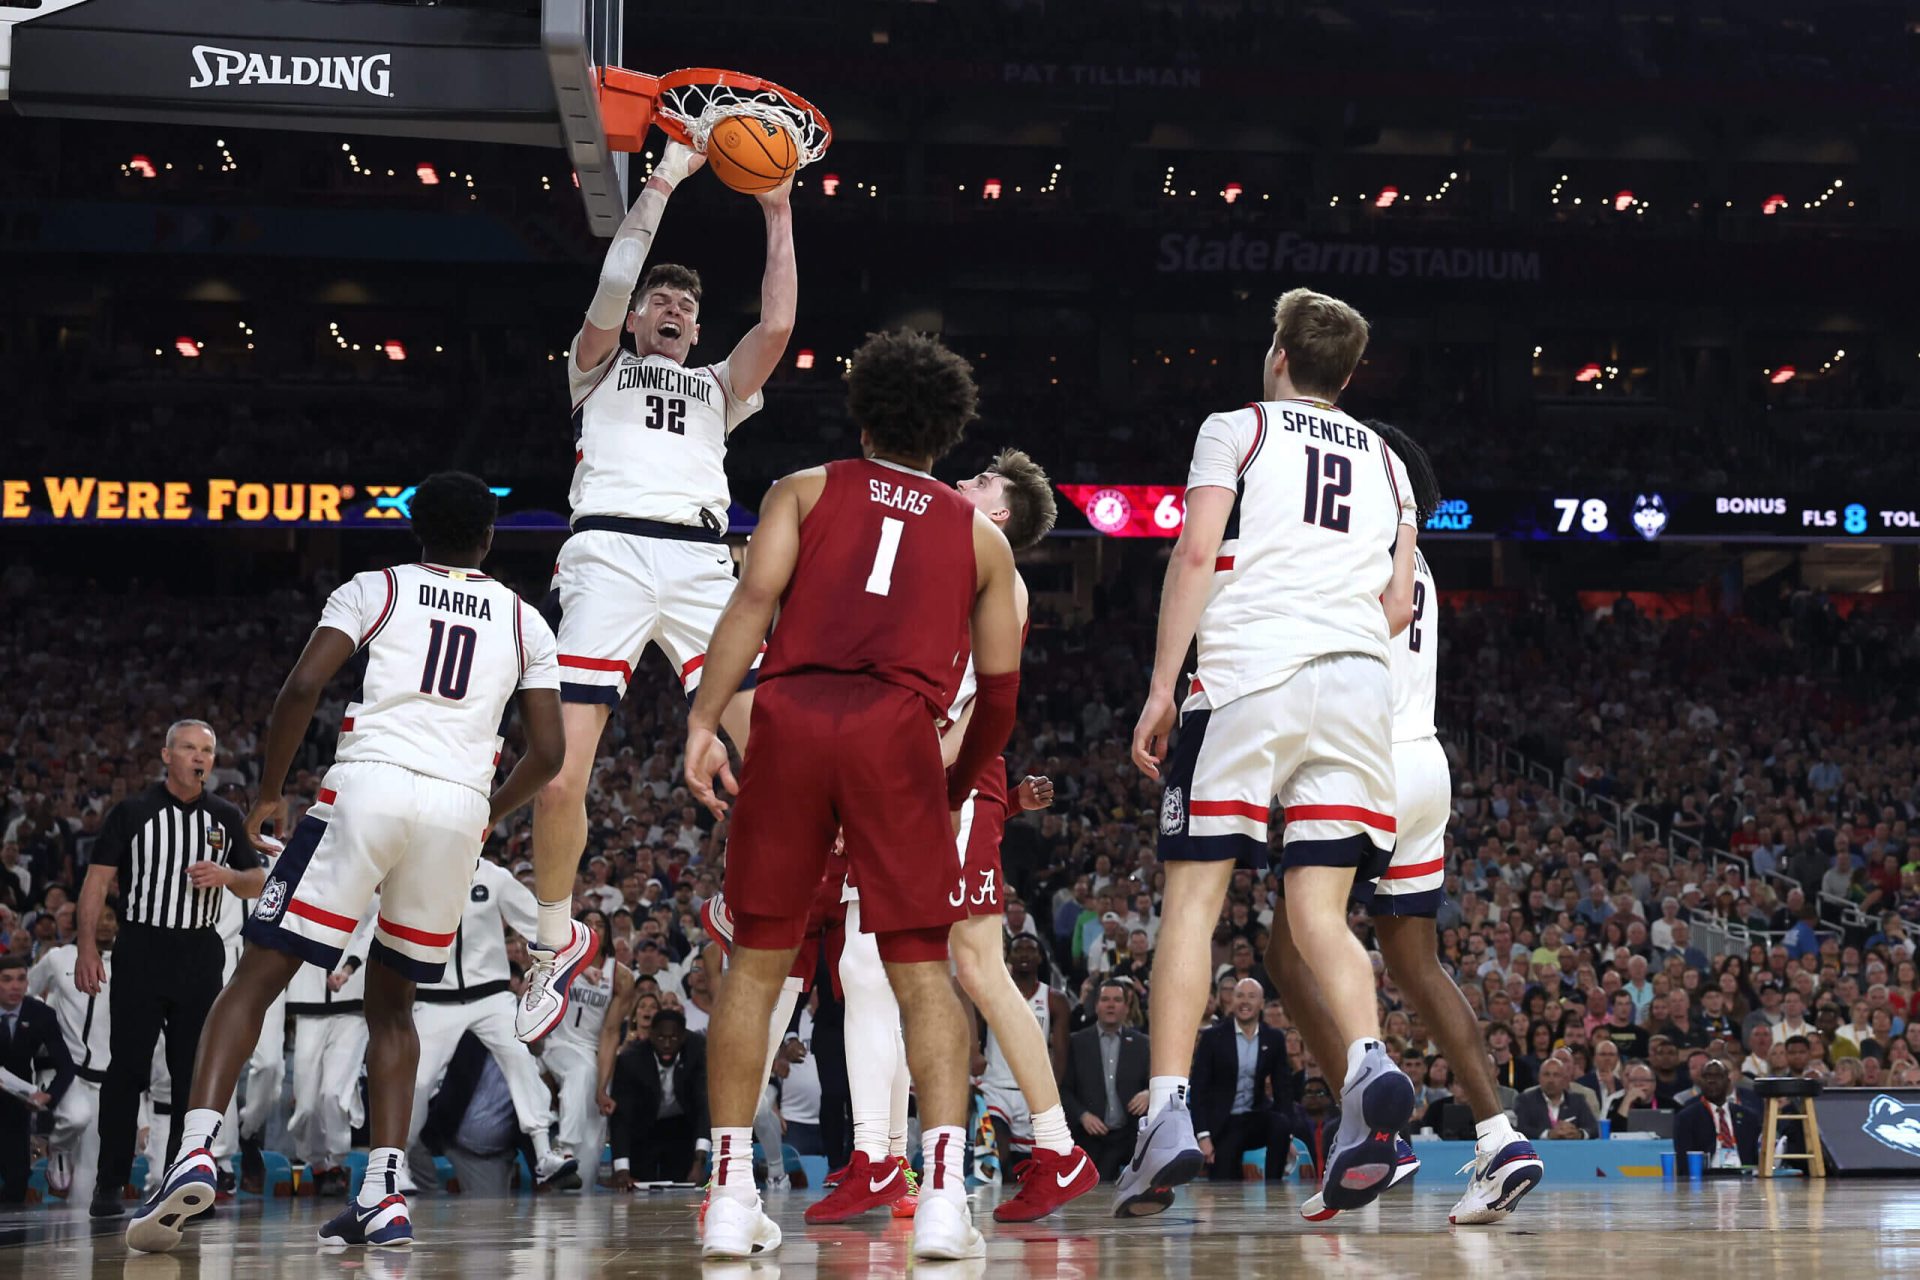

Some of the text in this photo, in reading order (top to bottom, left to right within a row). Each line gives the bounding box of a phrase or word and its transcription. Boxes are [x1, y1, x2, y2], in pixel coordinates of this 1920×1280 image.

[190, 45, 391, 97] SPALDING
[1003, 62, 1201, 88] PAT TILLMAN
[1387, 246, 1541, 281] STADIUM
[617, 365, 711, 407] CONNECTICUT
[645, 394, 686, 436] 32
[1282, 410, 1370, 452] SPENCER
[44, 477, 193, 519] WERE
[869, 478, 933, 515] SEARS
[1303, 444, 1352, 533] 12
[1716, 497, 1786, 514] BONUS
[1154, 494, 1187, 529] 6
[1426, 514, 1472, 530] HALF
[1554, 498, 1608, 533] 78
[1802, 503, 1920, 534] FLS 8 TOL
[865, 516, 905, 596] 1
[419, 584, 492, 622] DIARRA
[420, 618, 477, 701] 10
[971, 868, 997, 905] A
[574, 1006, 583, 1027] 1
